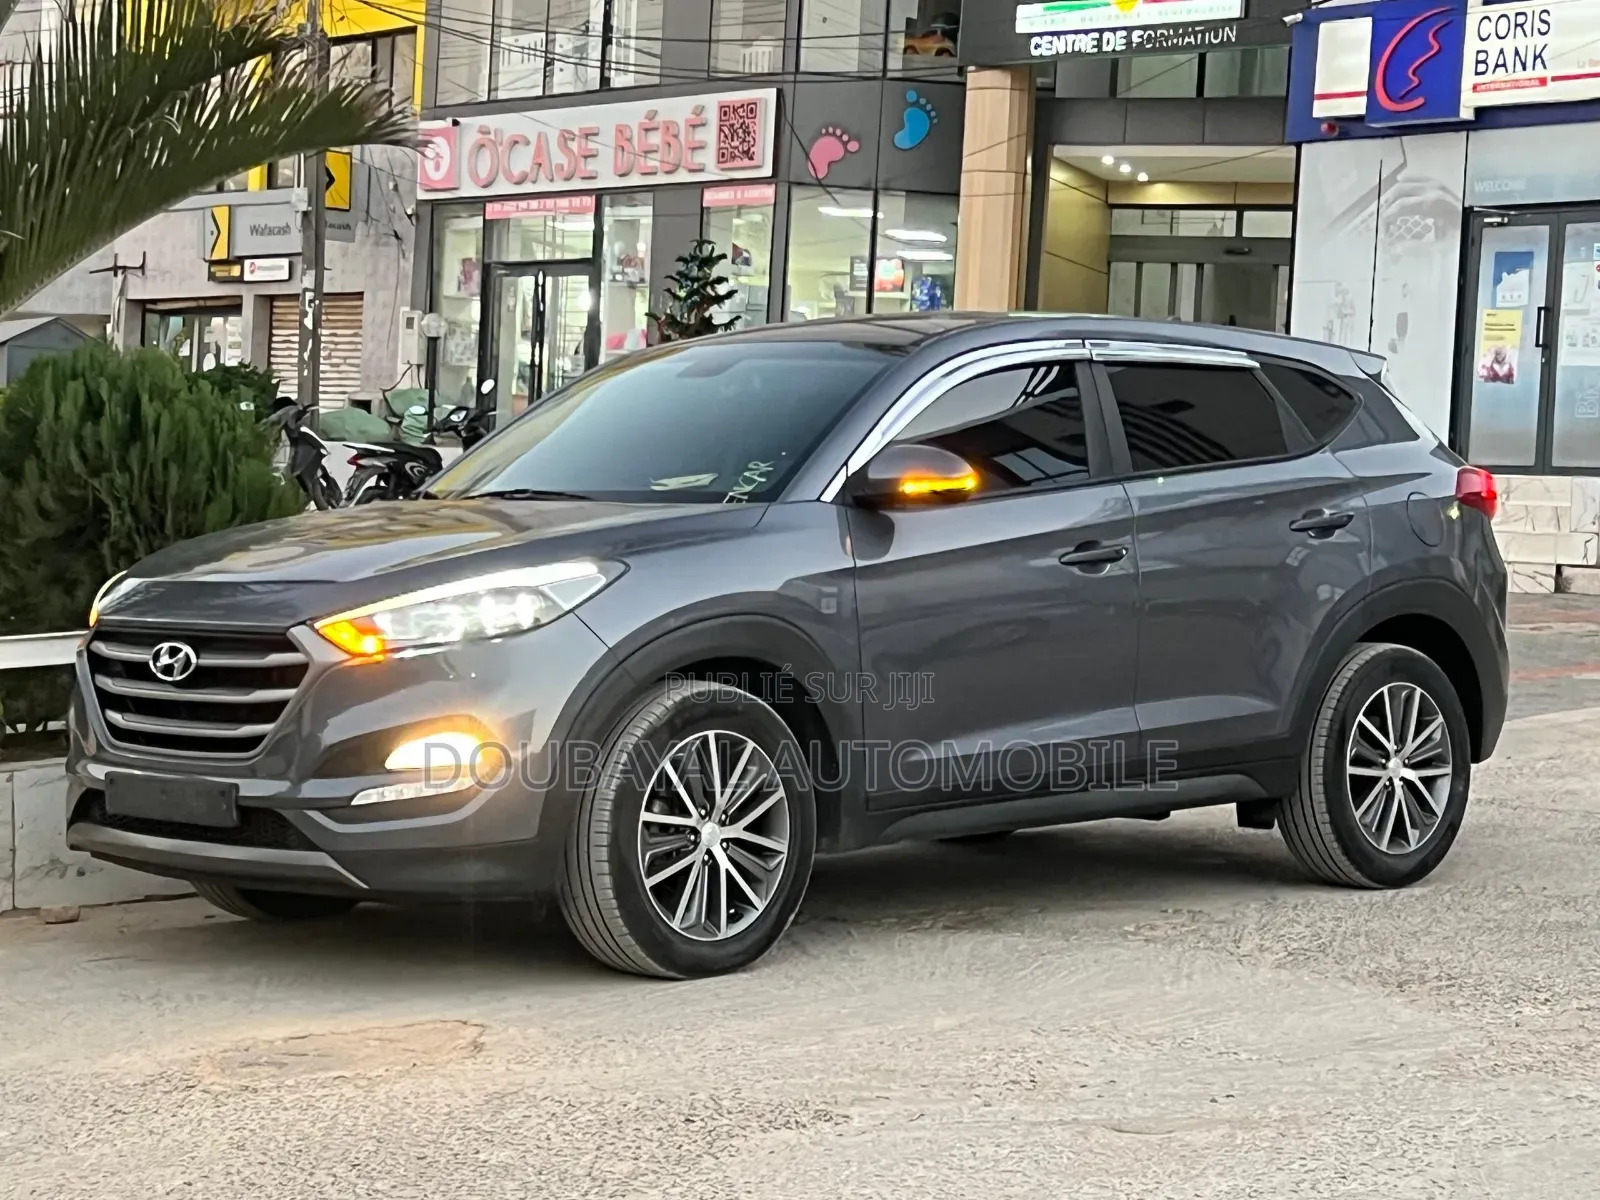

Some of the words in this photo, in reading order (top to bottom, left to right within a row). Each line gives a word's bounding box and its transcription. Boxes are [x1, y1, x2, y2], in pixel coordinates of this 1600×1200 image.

[1030, 33, 1099, 56] CENTRE
[1102, 30, 1127, 52] DE
[1131, 25, 1237, 49] FORMATION
[1477, 9, 1551, 42] CORIS
[1474, 43, 1548, 76] BANK
[613, 104, 708, 177] BÉBÉ
[250, 222, 292, 237] Wafacash
